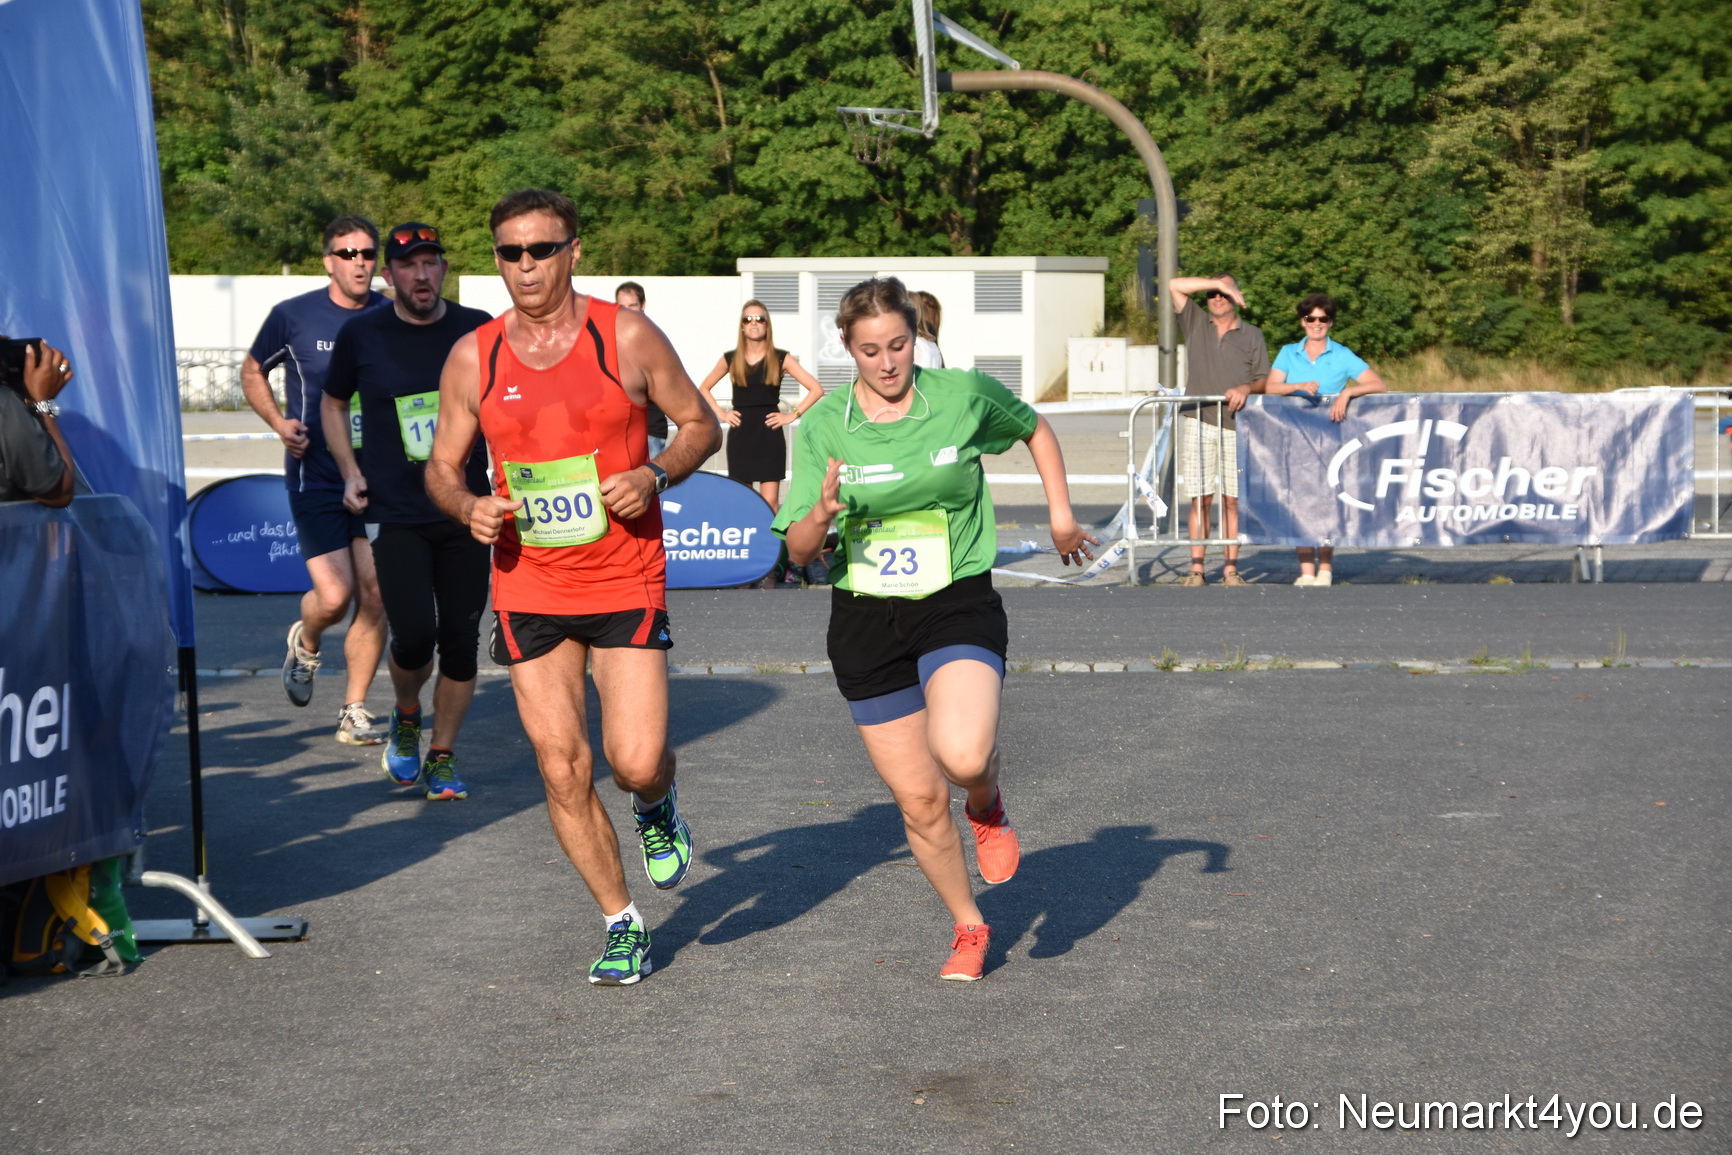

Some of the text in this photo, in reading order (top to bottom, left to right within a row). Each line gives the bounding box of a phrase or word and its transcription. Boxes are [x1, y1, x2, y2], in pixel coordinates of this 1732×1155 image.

[316, 339, 335, 351] EU
[1375, 456, 1598, 499] Fischer
[522, 492, 593, 524] 1390
[1395, 503, 1580, 523] AUTOMOBILE
[227, 524, 256, 543] und
[260, 521, 284, 537] das
[662, 521, 757, 547] scher
[878, 547, 919, 576] 23
[0, 774, 68, 829] OBILE
